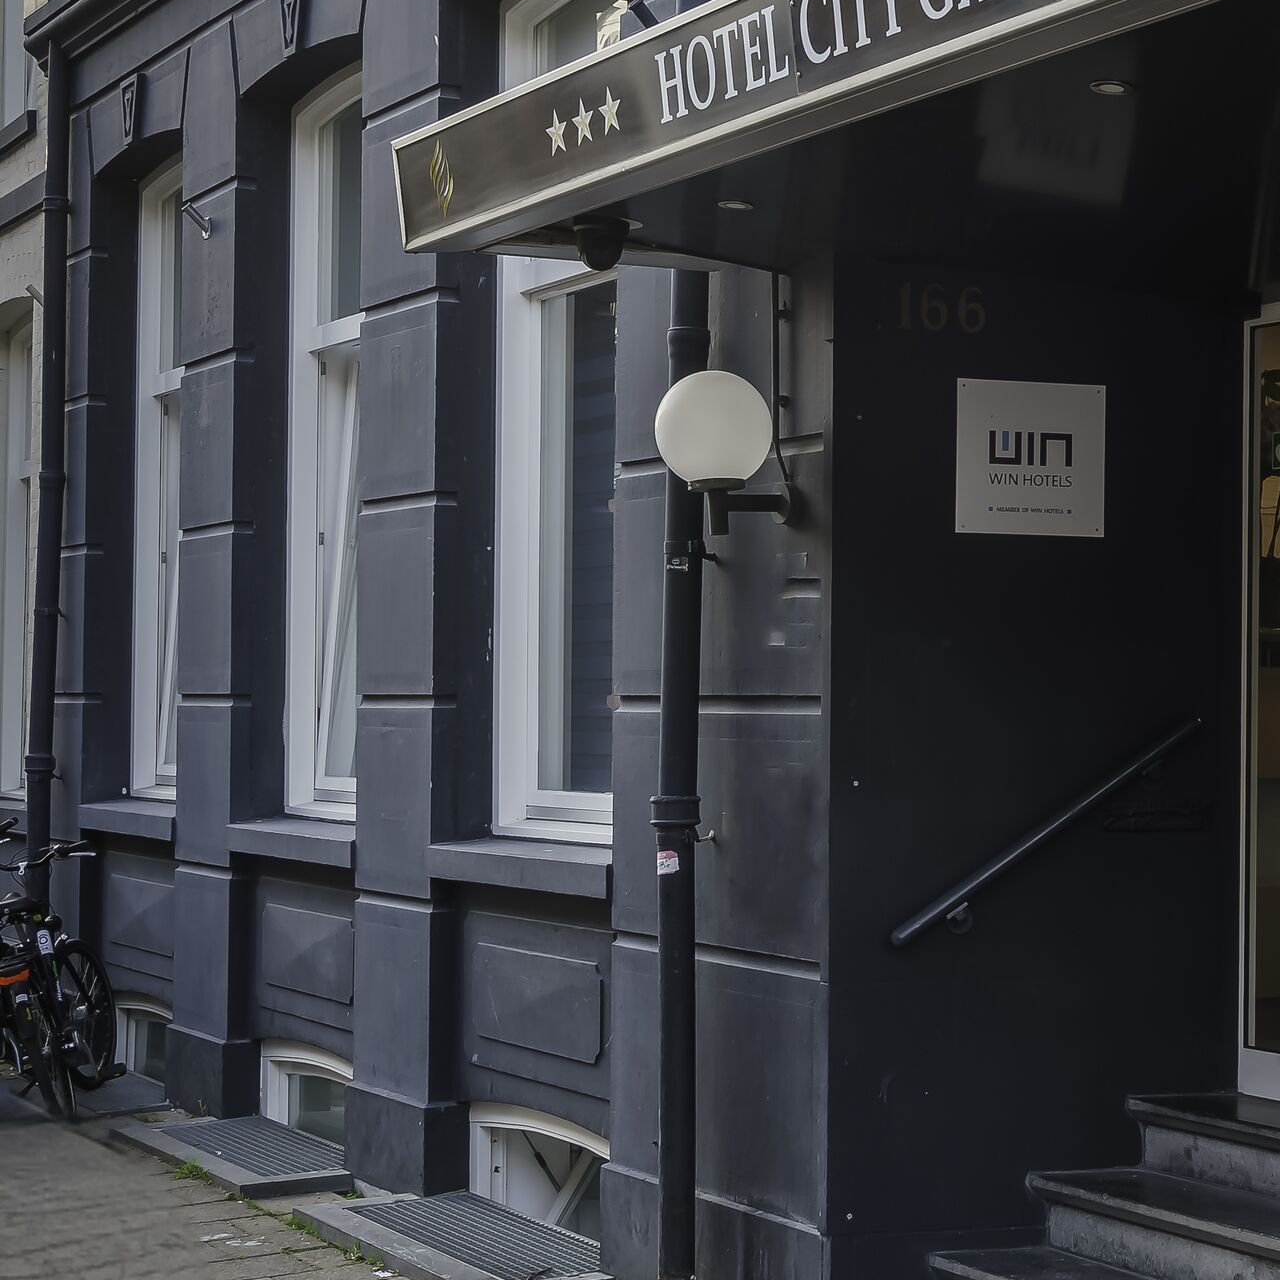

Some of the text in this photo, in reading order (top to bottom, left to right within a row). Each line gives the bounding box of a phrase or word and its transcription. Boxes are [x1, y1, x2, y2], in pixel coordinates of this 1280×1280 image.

[655, 5, 790, 124] HOTEL
[898, 281, 986, 332] 166
[989, 473, 1073, 488] WIN HOTELS
